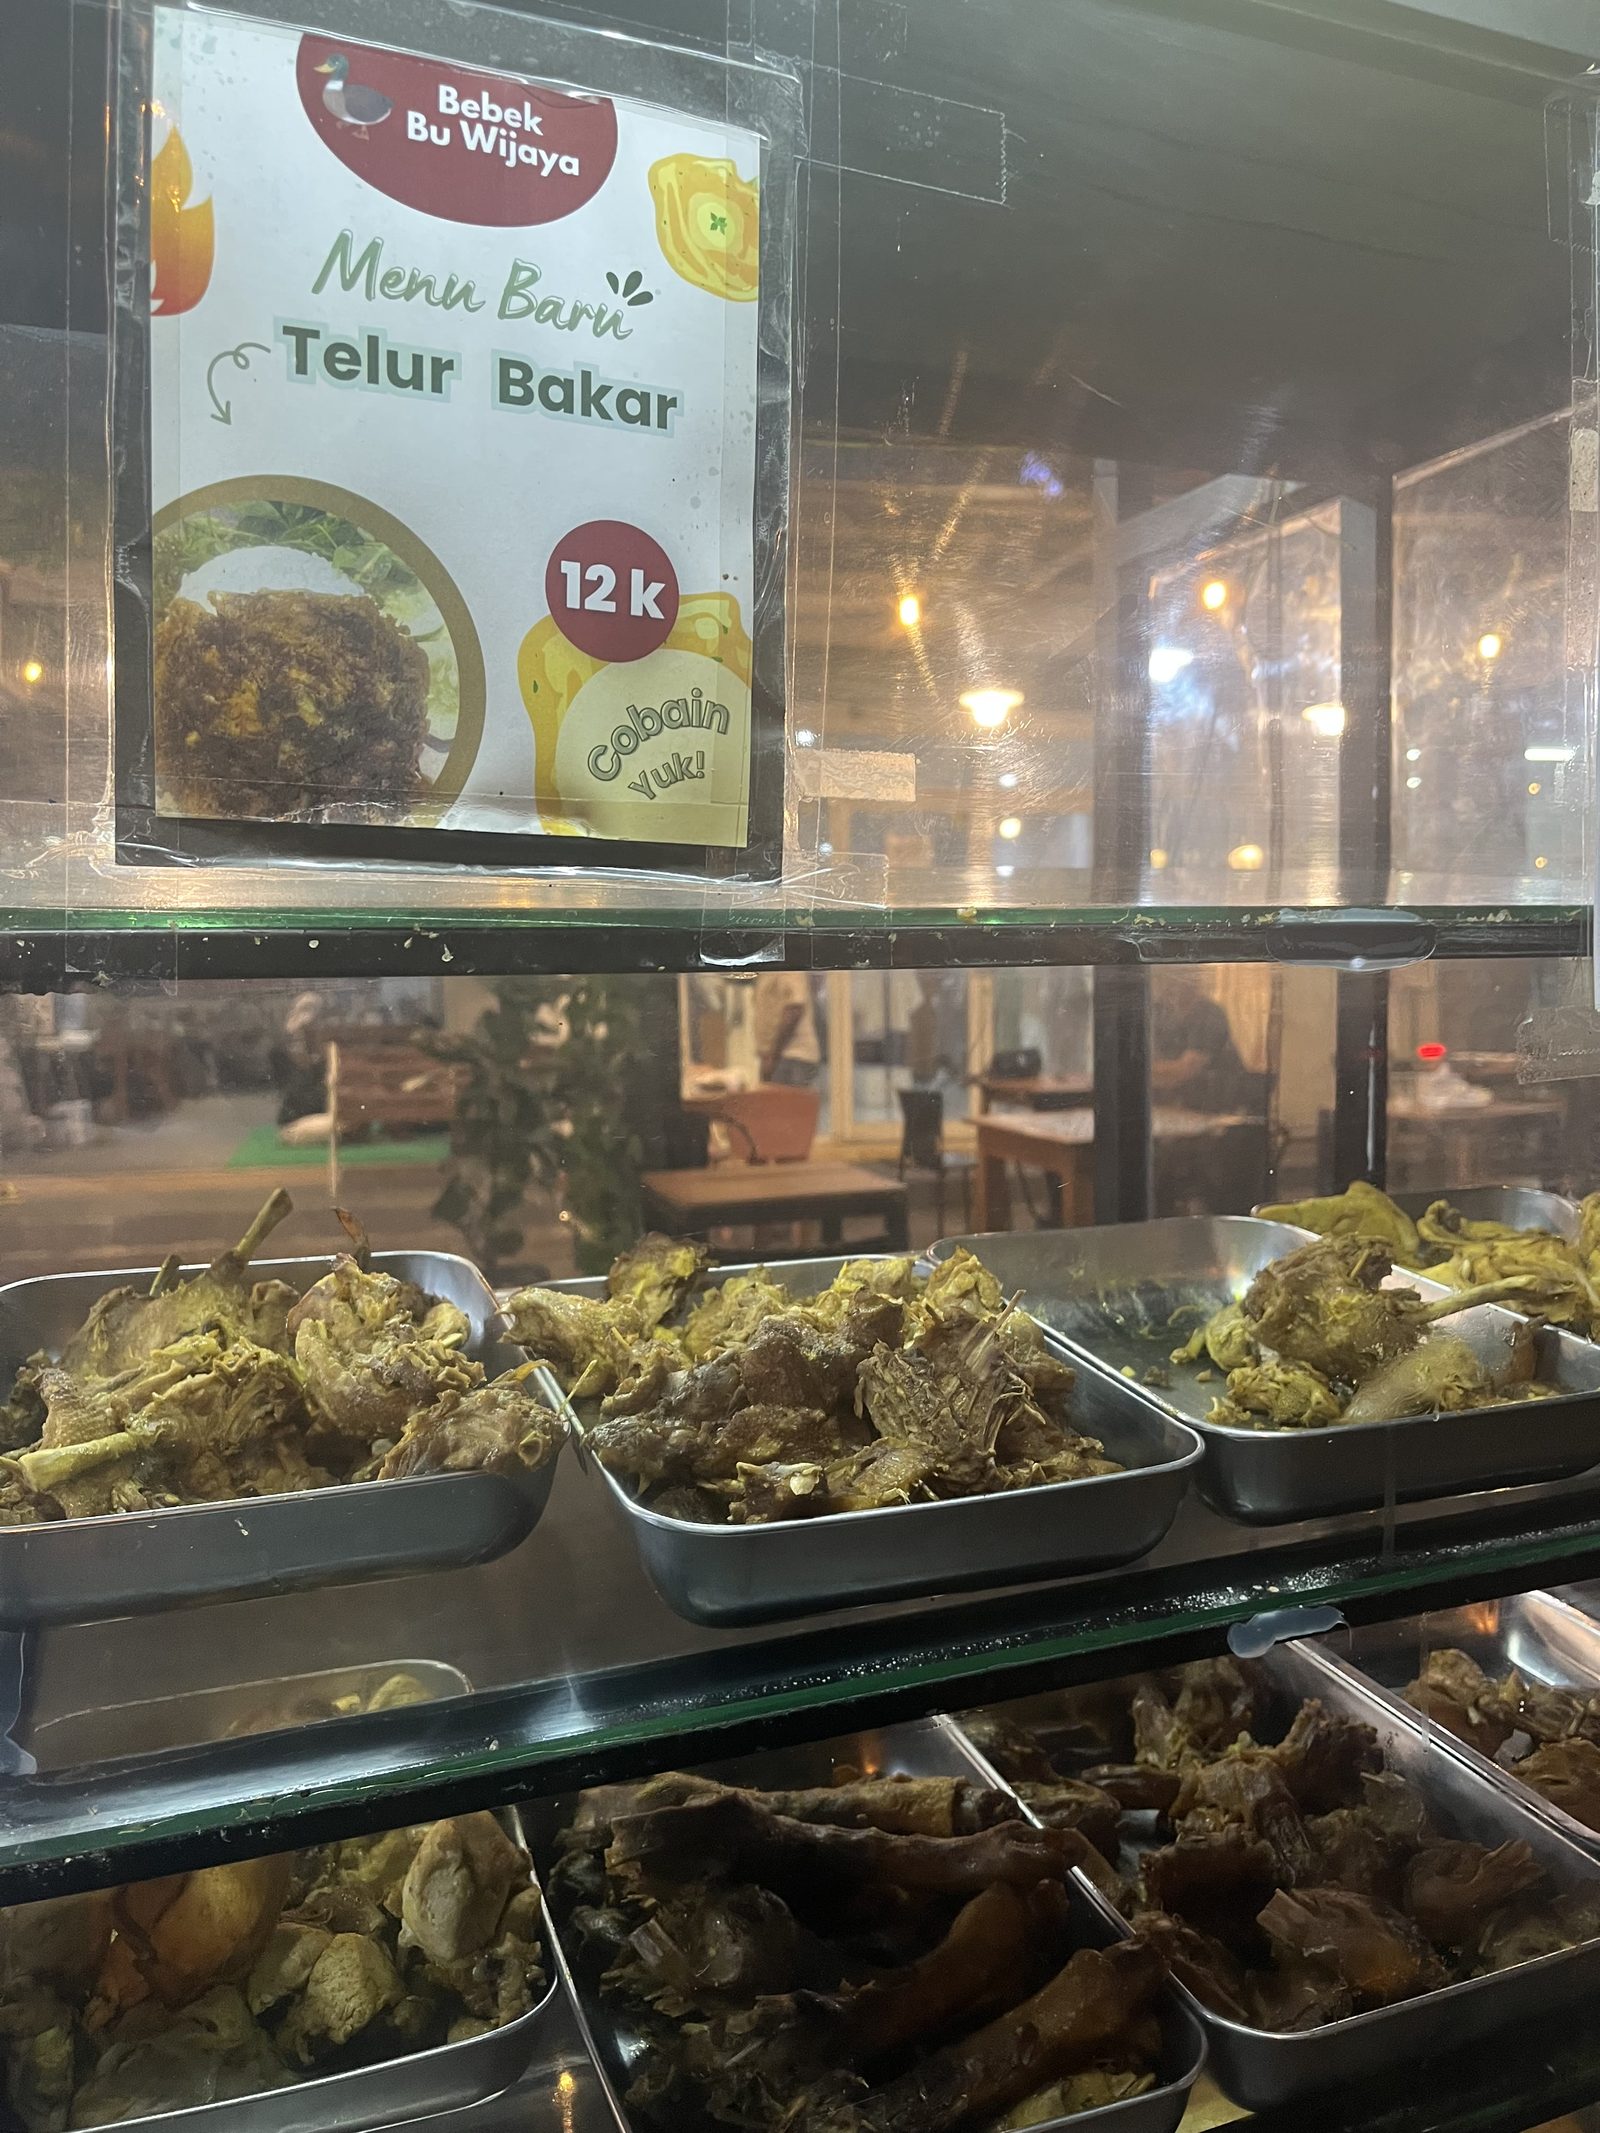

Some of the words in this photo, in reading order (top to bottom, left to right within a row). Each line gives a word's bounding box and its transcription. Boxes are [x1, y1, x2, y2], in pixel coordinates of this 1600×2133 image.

[406, 110, 451, 147] Bu
[458, 120, 581, 178] Wijaya
[438, 84, 544, 137] Bebek
[311, 228, 486, 313] Menu
[497, 257, 634, 341] Baru
[282, 324, 455, 395] Telur
[498, 357, 678, 431] Bakar
[587, 686, 731, 782] Cobain
[627, 750, 706, 801] Yuk!
